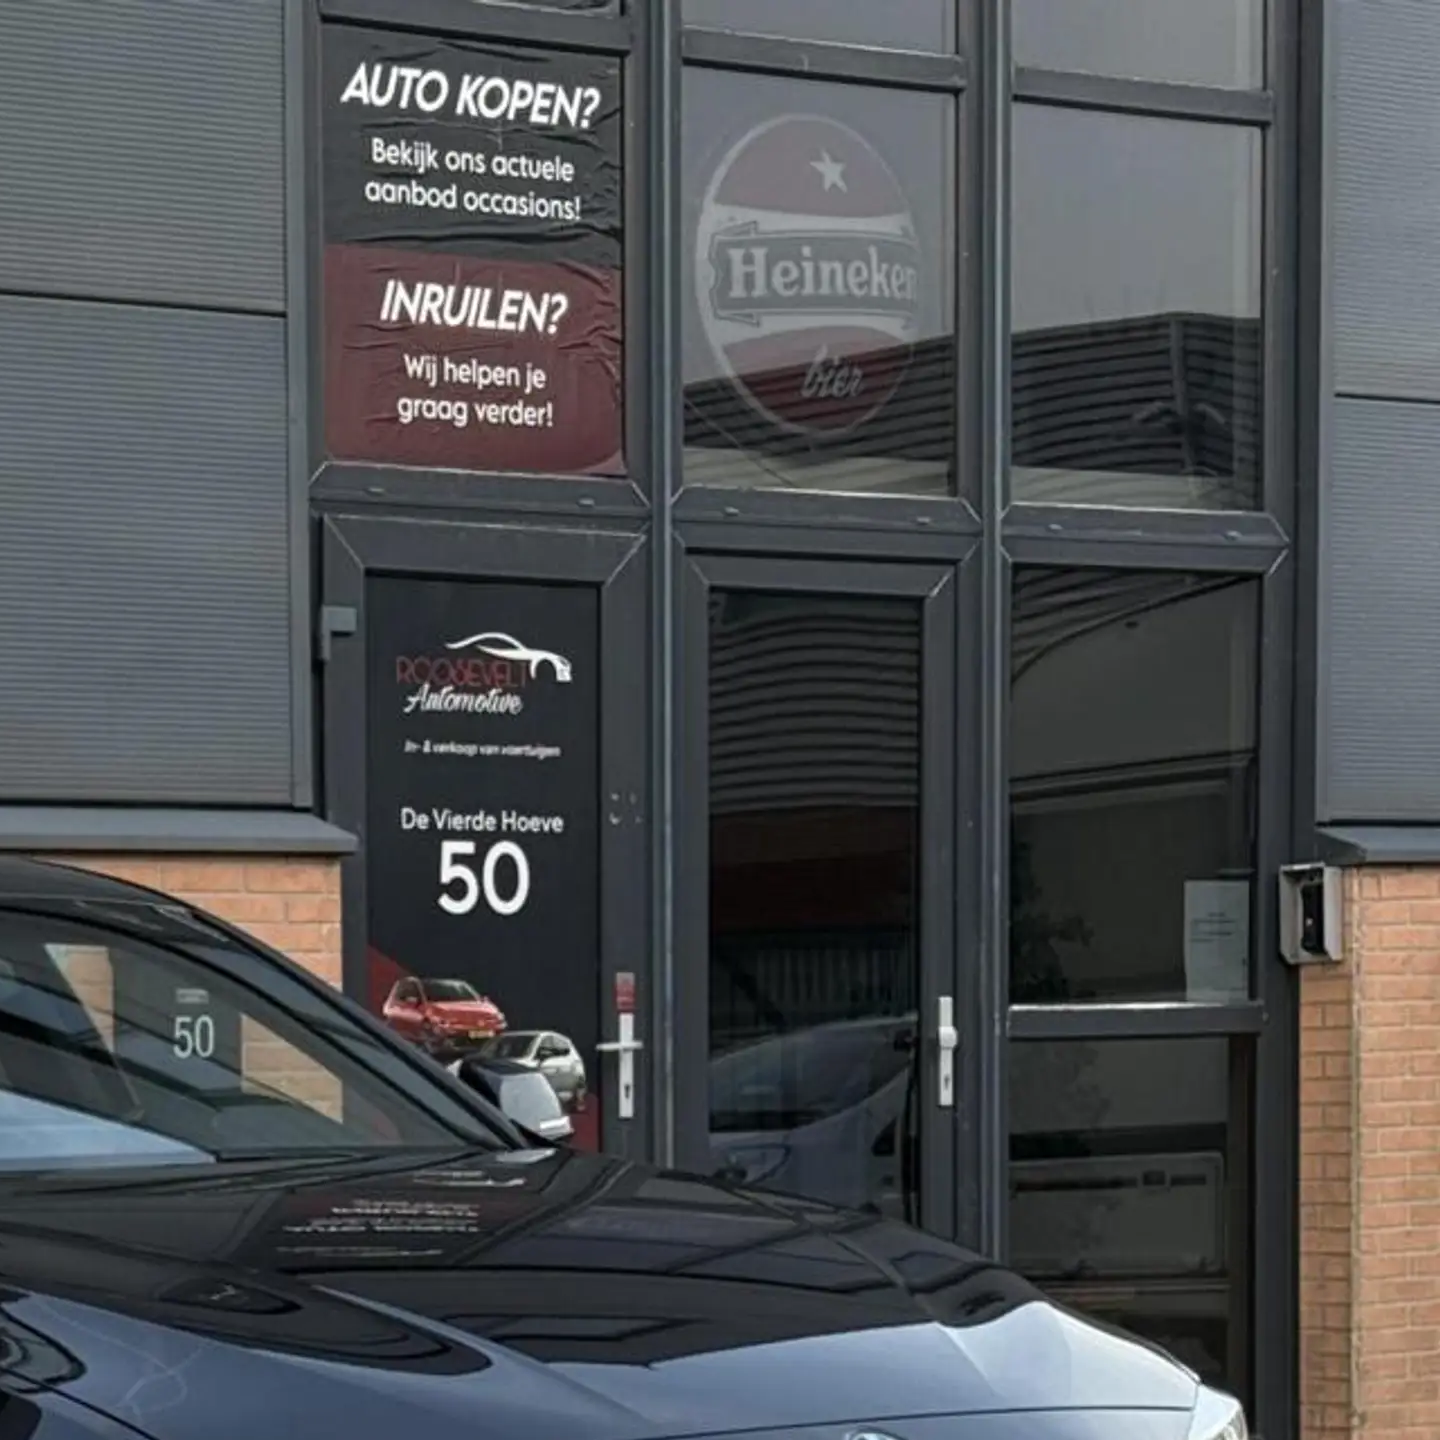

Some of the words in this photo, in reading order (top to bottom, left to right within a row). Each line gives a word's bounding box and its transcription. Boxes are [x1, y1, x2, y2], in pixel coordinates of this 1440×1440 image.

[340, 61, 449, 112] AUTO
[455, 73, 601, 129] KOPEN?
[371, 137, 438, 173] Bekijk
[445, 151, 486, 173] ons
[491, 155, 575, 182] actuele
[364, 180, 458, 209] aanbod
[463, 191, 581, 221] occasions!
[727, 244, 917, 299] Heineken
[379, 279, 569, 335] INRUILEN?
[403, 353, 437, 387] Wij
[443, 356, 520, 390] helpen
[524, 362, 547, 394] je
[397, 397, 468, 427] graag
[473, 400, 553, 427] verder!
[403, 683, 523, 714] Automotive
[401, 807, 429, 829] De
[432, 808, 496, 831] Vierde
[501, 810, 564, 833] Hoeve
[437, 840, 530, 915] 50
[173, 1014, 215, 1058] 50
